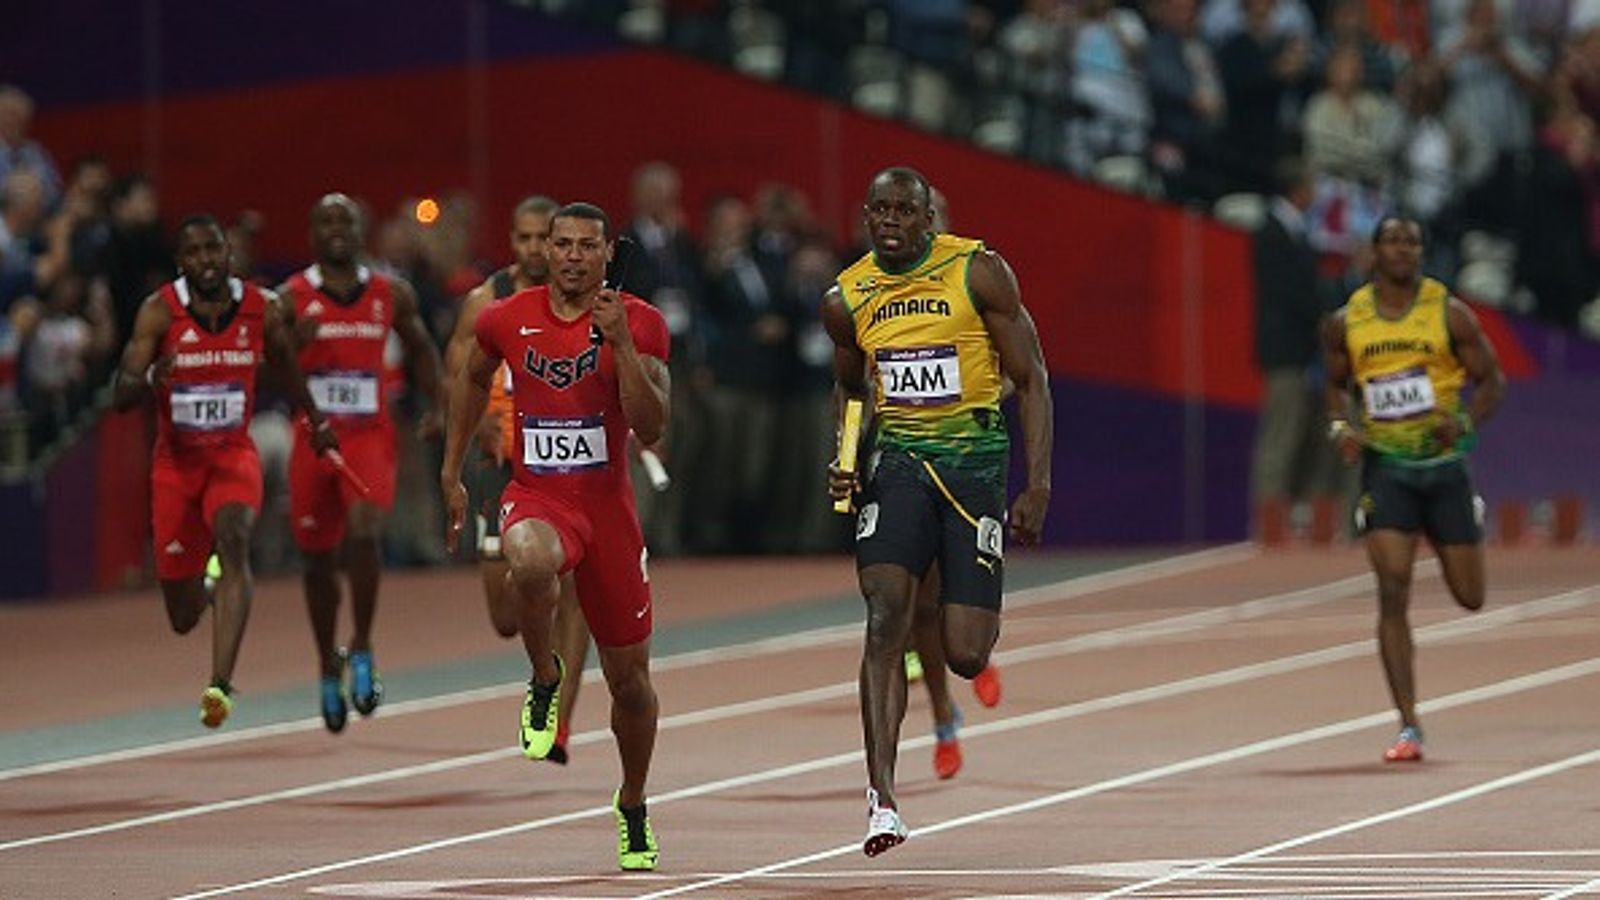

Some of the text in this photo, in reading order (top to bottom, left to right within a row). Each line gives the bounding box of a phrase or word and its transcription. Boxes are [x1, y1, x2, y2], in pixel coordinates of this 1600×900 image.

[867, 299, 951, 330] JAMAICA
[525, 345, 599, 391] USA
[890, 364, 947, 392] JAM
[194, 399, 227, 421] TRI
[534, 434, 593, 460] USA
[987, 523, 998, 550] 6
